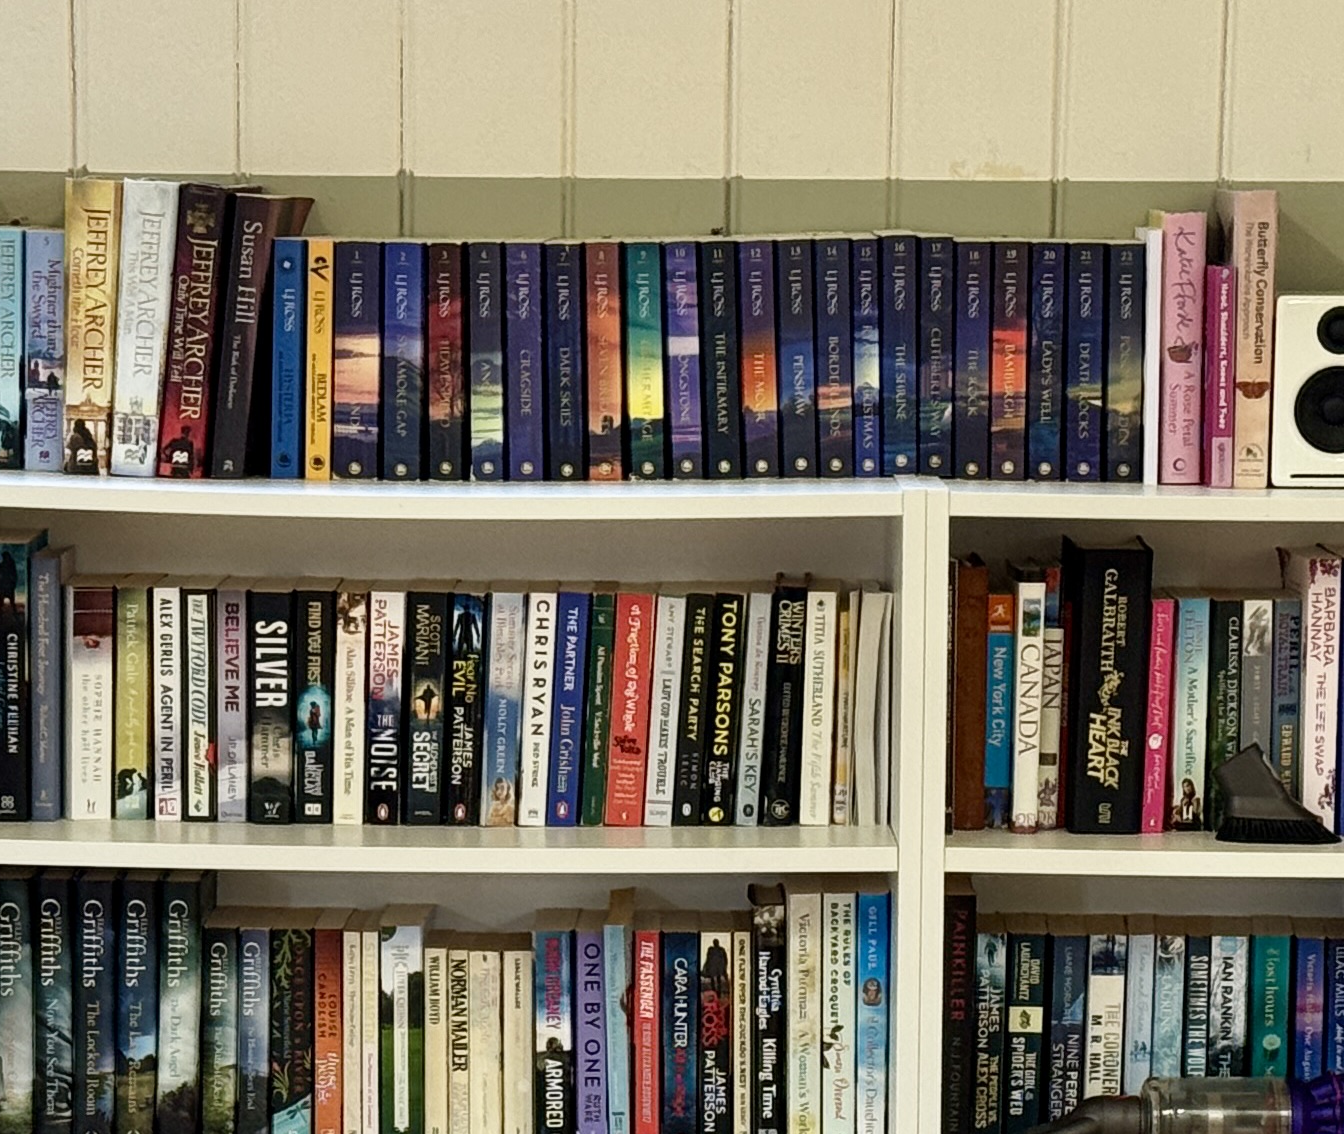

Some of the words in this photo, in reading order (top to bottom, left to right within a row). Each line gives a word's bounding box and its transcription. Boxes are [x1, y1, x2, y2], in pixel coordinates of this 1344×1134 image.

[81, 208, 111, 290] JEFFREY
[239, 220, 262, 279] Susan
[1253, 221, 1269, 277] Butterfly
[186, 236, 219, 327] JEFFREY
[235, 285, 256, 324] Hill
[82, 295, 109, 391] ARCHER
[1252, 279, 1267, 364] Conservation
[179, 328, 208, 420] ARCHER
[558, 347, 571, 387] DARK
[560, 391, 572, 426] SKIES
[160, 598, 173, 628] ALEX
[533, 600, 550, 670] CHRIS
[566, 607, 578, 632] THE
[694, 607, 706, 633] THE
[720, 600, 737, 655] TONY
[1100, 569, 1118, 672] GALBRAITH
[1116, 596, 1128, 647] ROBERT
[1309, 592, 1323, 663] HANNAY
[1323, 587, 1336, 667] BARBARA
[160, 633, 173, 676] GERLIS
[225, 603, 240, 681] BELIEVE
[255, 620, 289, 707] SILVER
[563, 636, 577, 691] PARTNER
[690, 640, 704, 692] SEARCH
[994, 647, 1007, 679] New
[225, 686, 240, 712] ME
[452, 660, 465, 697] EVIL
[992, 683, 1006, 716] York
[1018, 644, 1041, 756] CANADA
[1042, 639, 1062, 710] JAPAN
[160, 684, 173, 731] AGENT
[531, 677, 548, 736] RYAN
[687, 698, 701, 741] PARTY
[713, 662, 734, 756] PARSONS
[1107, 707, 1122, 737] INK
[160, 737, 173, 752] IN
[451, 707, 465, 785] PATTERSON
[463, 725, 474, 768] JAMES
[989, 719, 1006, 747] City
[1087, 712, 1106, 783] HEART
[161, 758, 173, 792] PERIL
[371, 728, 397, 791] NOISE
[412, 731, 430, 792] SECRET
[1104, 739, 1120, 789] BLACK
[584, 943, 600, 992] ONE
[1221, 956, 1234, 982] IAN
[584, 1002, 600, 1030] BY
[1220, 986, 1234, 1041] RANKIN
[585, 1039, 601, 1087] ONE
[759, 1038, 777, 1081] Killing
[545, 1059, 563, 1128] ARMORED
[704, 1050, 716, 1132] PATTERSON
[715, 1068, 726, 1114] JAMES
[761, 1084, 775, 1119] Time
